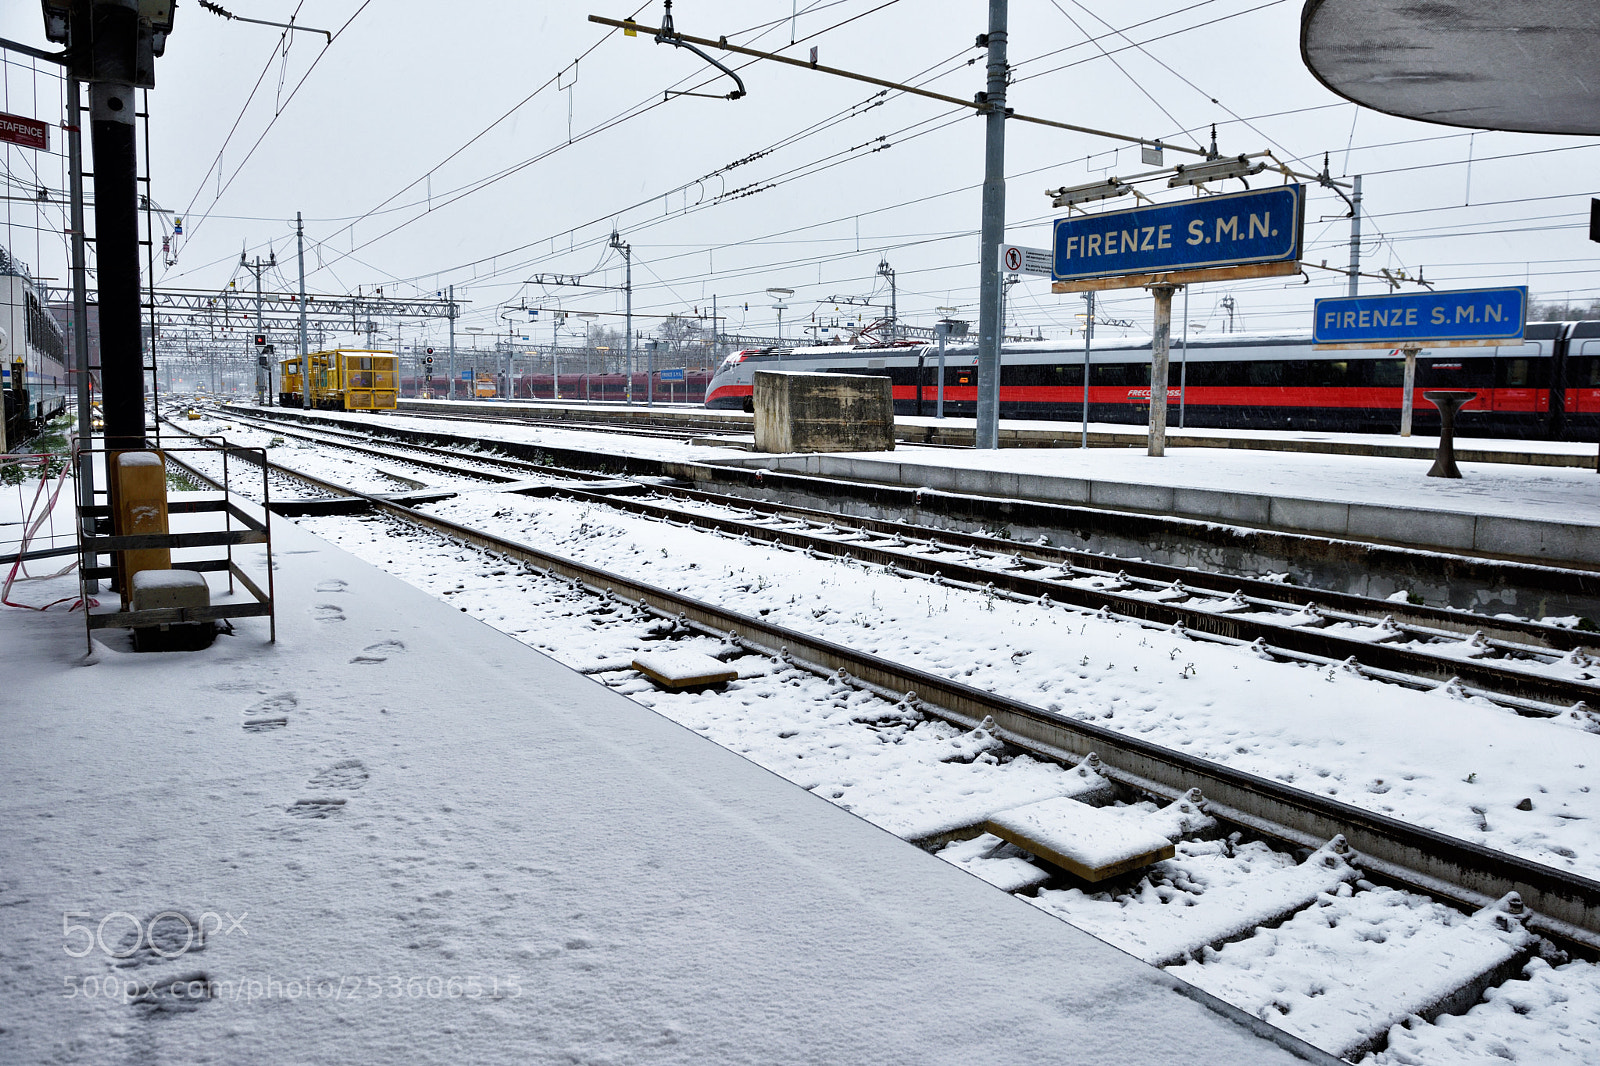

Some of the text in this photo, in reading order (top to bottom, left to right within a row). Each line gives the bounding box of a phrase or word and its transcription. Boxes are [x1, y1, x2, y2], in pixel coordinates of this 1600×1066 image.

[1066, 211, 1279, 260] FIRENZE S.M.N.
[1324, 303, 1509, 329] FIRENZE S.M.N.
